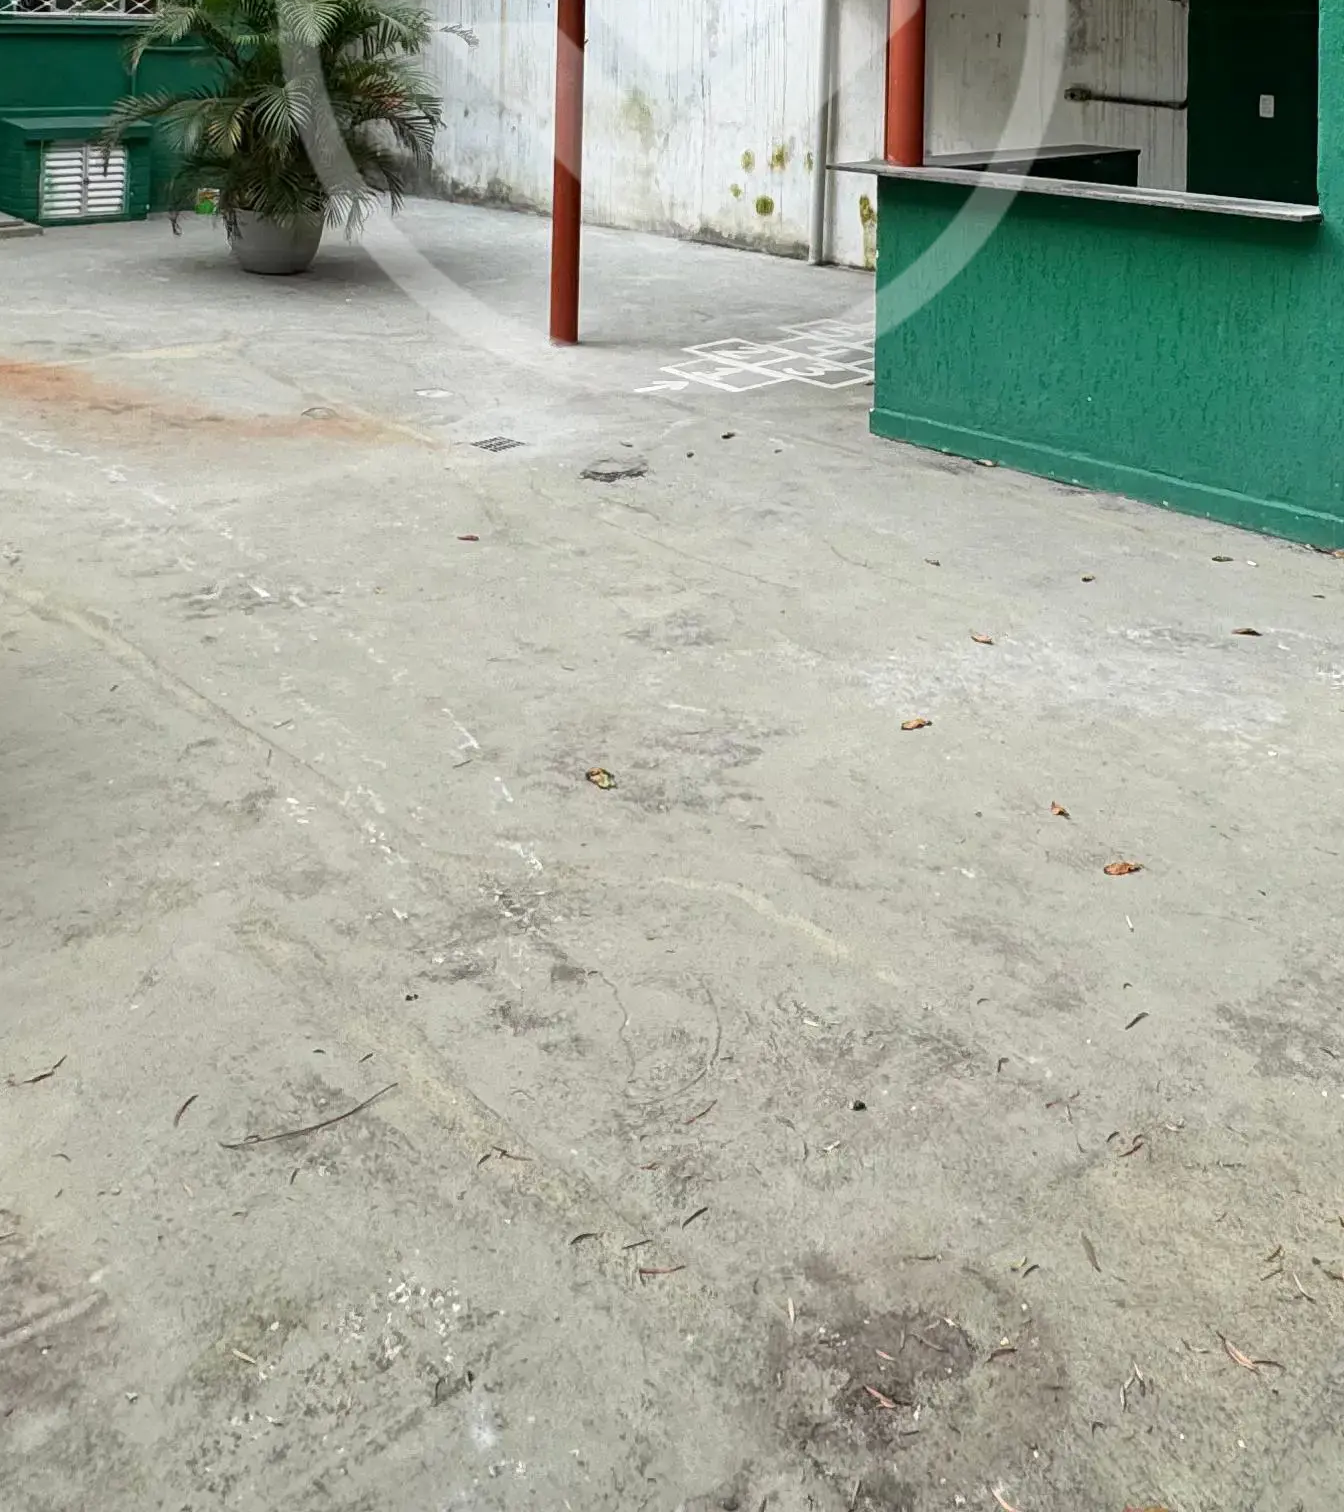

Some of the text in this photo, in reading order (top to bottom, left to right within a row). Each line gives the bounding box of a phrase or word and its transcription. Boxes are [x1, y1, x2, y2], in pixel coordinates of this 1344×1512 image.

[712, 346, 769, 359] 2
[692, 367, 744, 380] 1
[783, 362, 846, 376] 3
